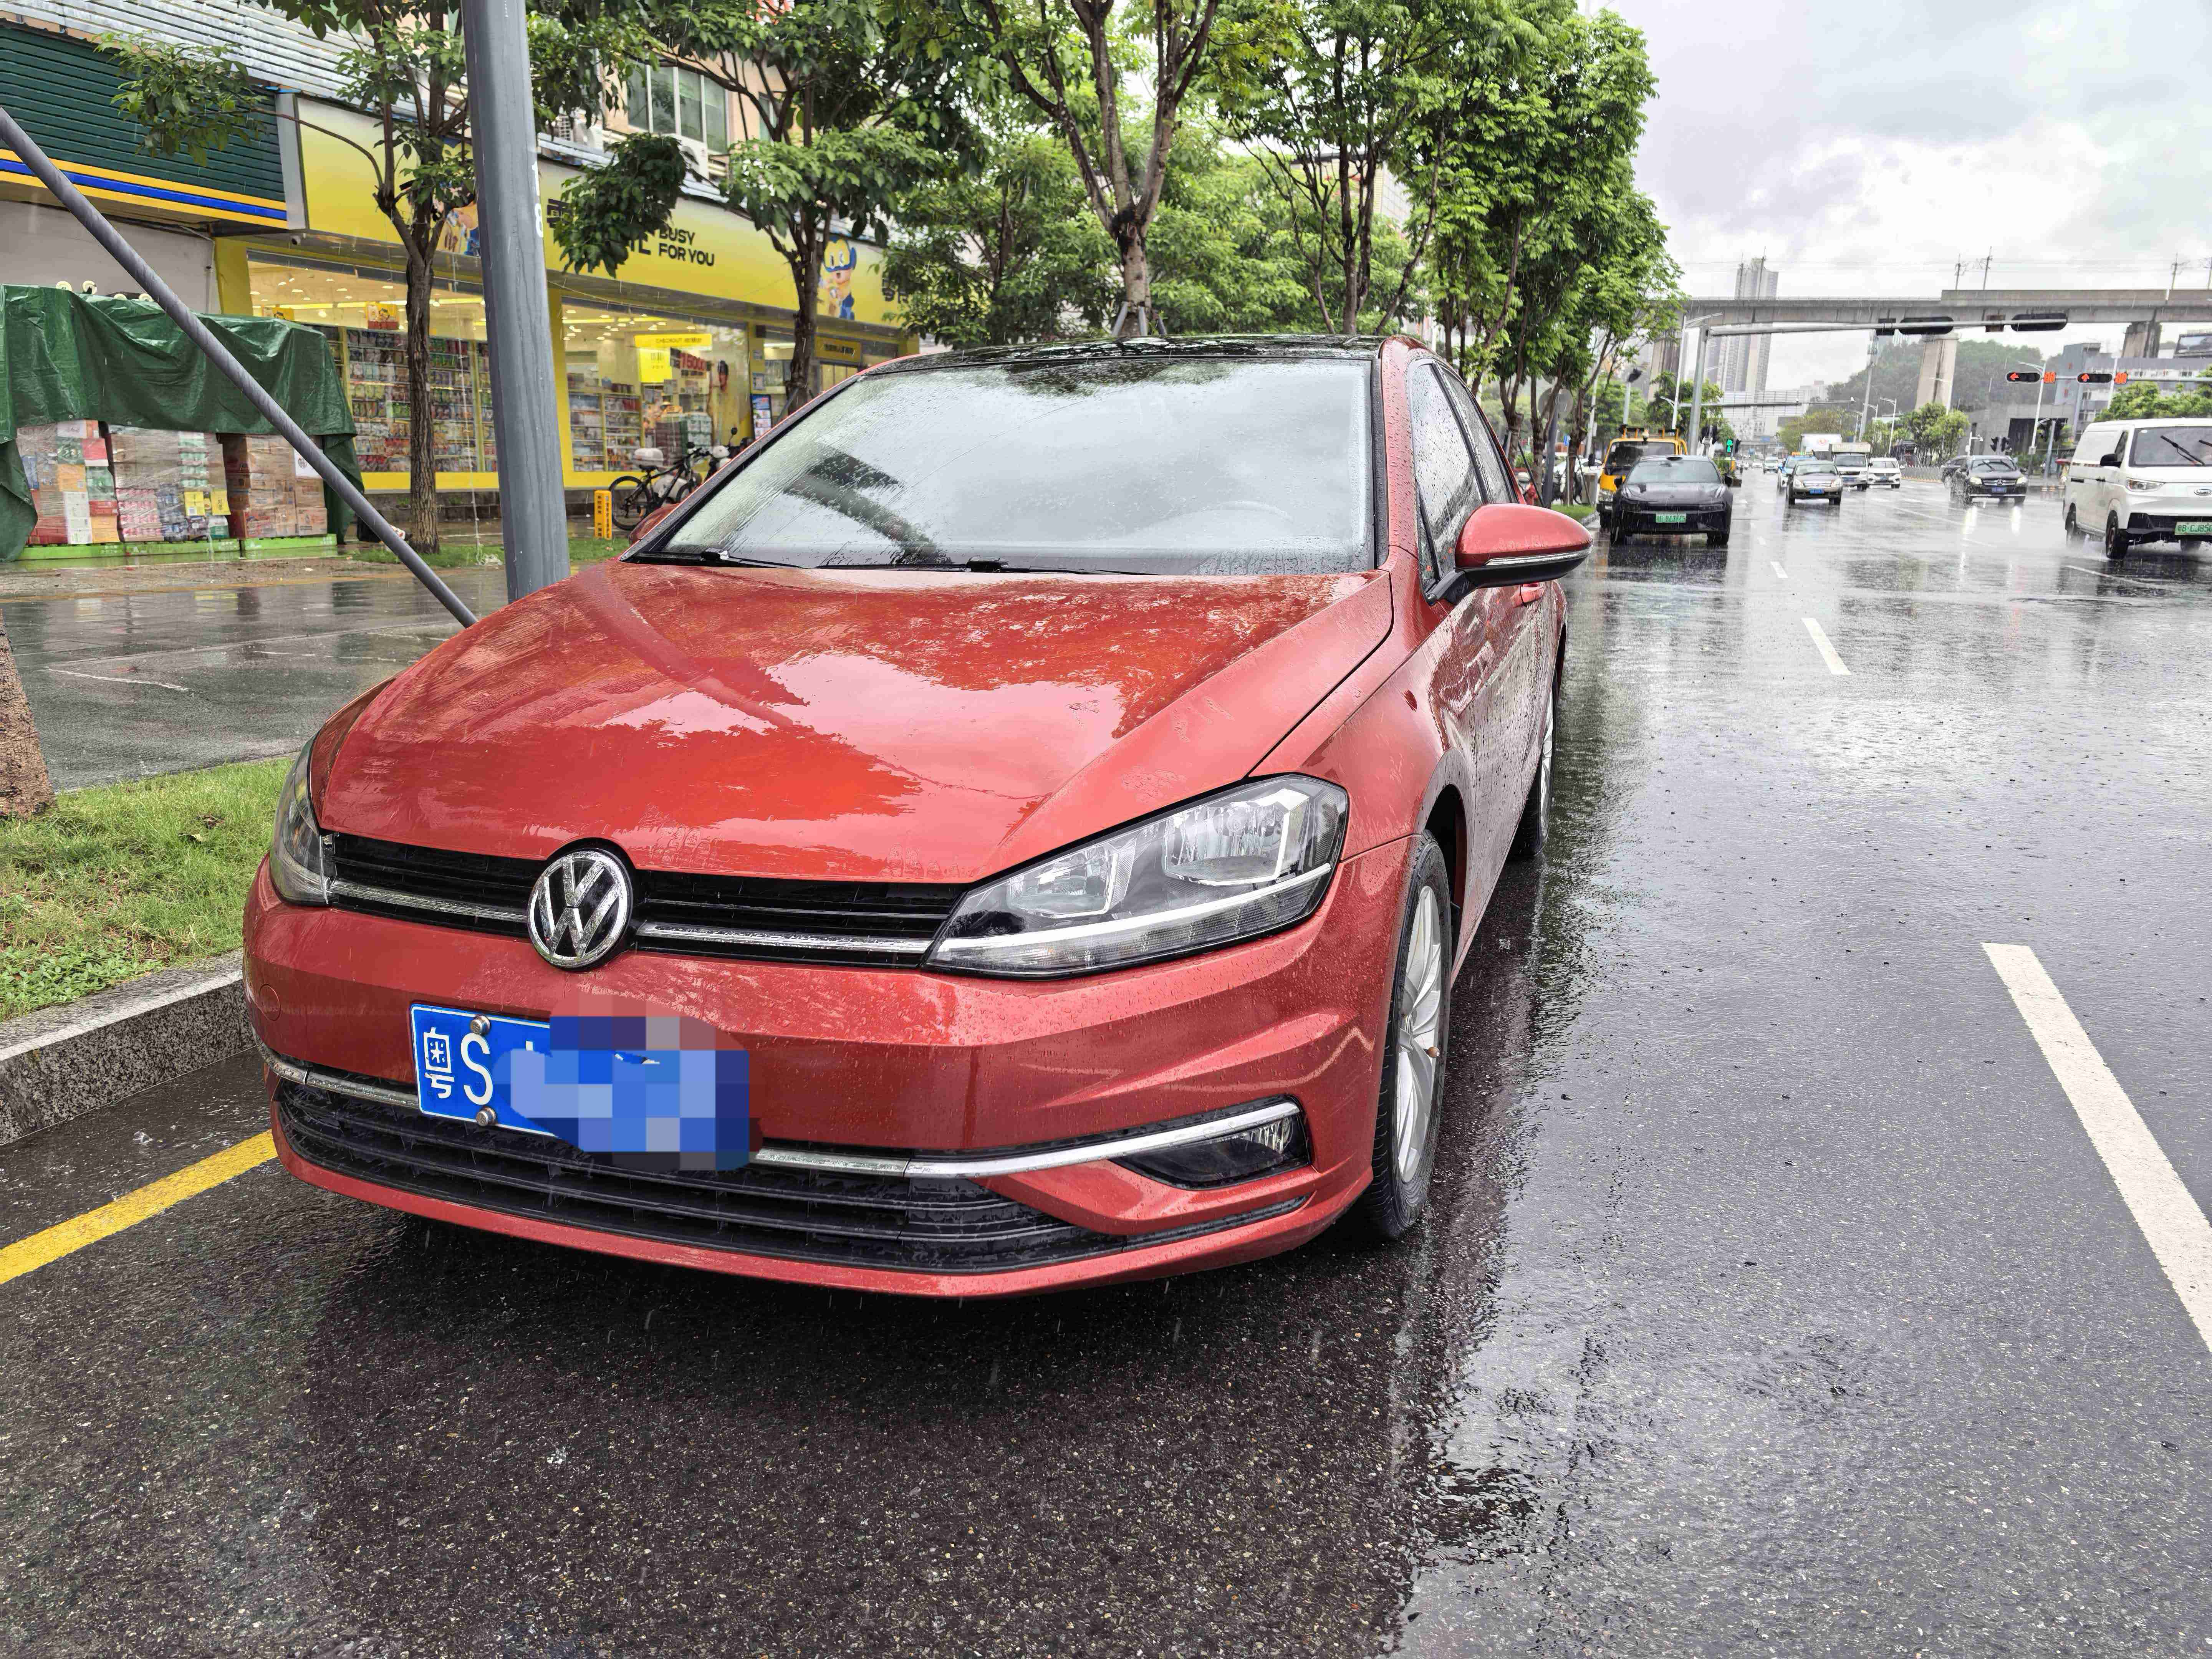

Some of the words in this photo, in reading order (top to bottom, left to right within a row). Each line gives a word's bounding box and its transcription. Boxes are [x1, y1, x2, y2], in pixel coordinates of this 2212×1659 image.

[659, 228, 695, 245] BUSY
[658, 242, 686, 262] FOR
[688, 248, 715, 266] YOU
[536, 853, 621, 960] VW
